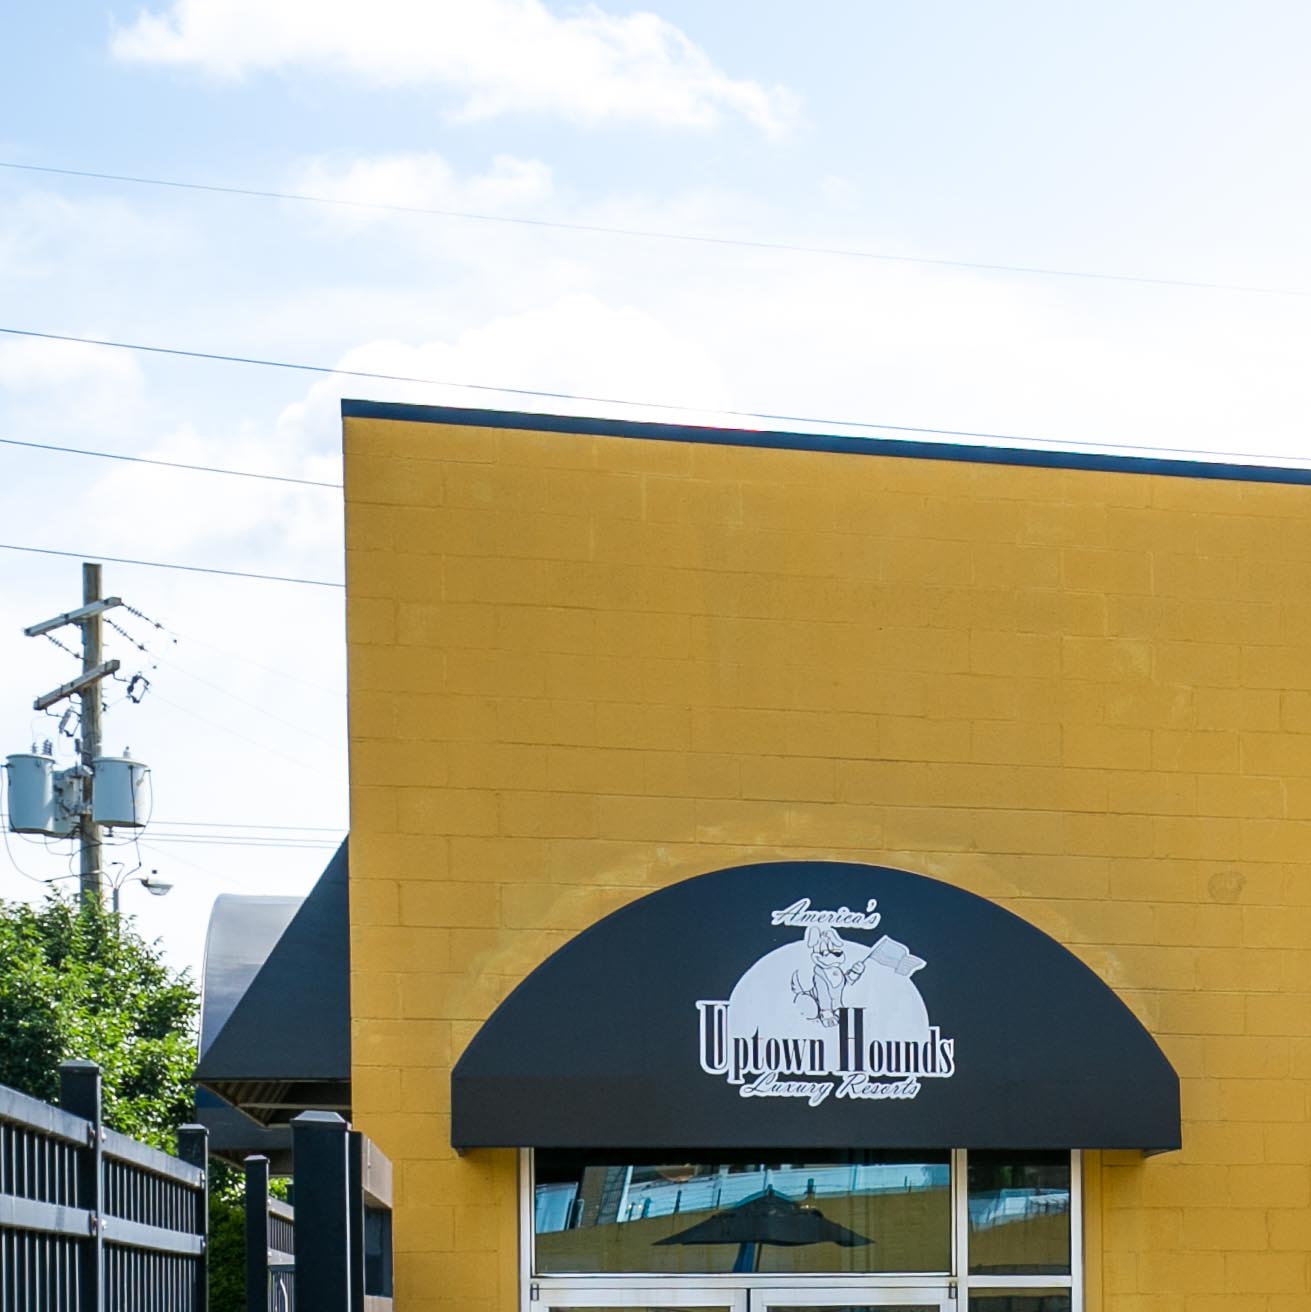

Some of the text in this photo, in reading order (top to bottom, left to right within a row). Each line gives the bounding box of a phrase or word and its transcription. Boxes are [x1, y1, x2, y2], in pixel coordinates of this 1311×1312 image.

[772, 899, 880, 929] America's
[699, 1001, 955, 1081] Uptown Hounds
[743, 1073, 920, 1104] Luxury Resorts
